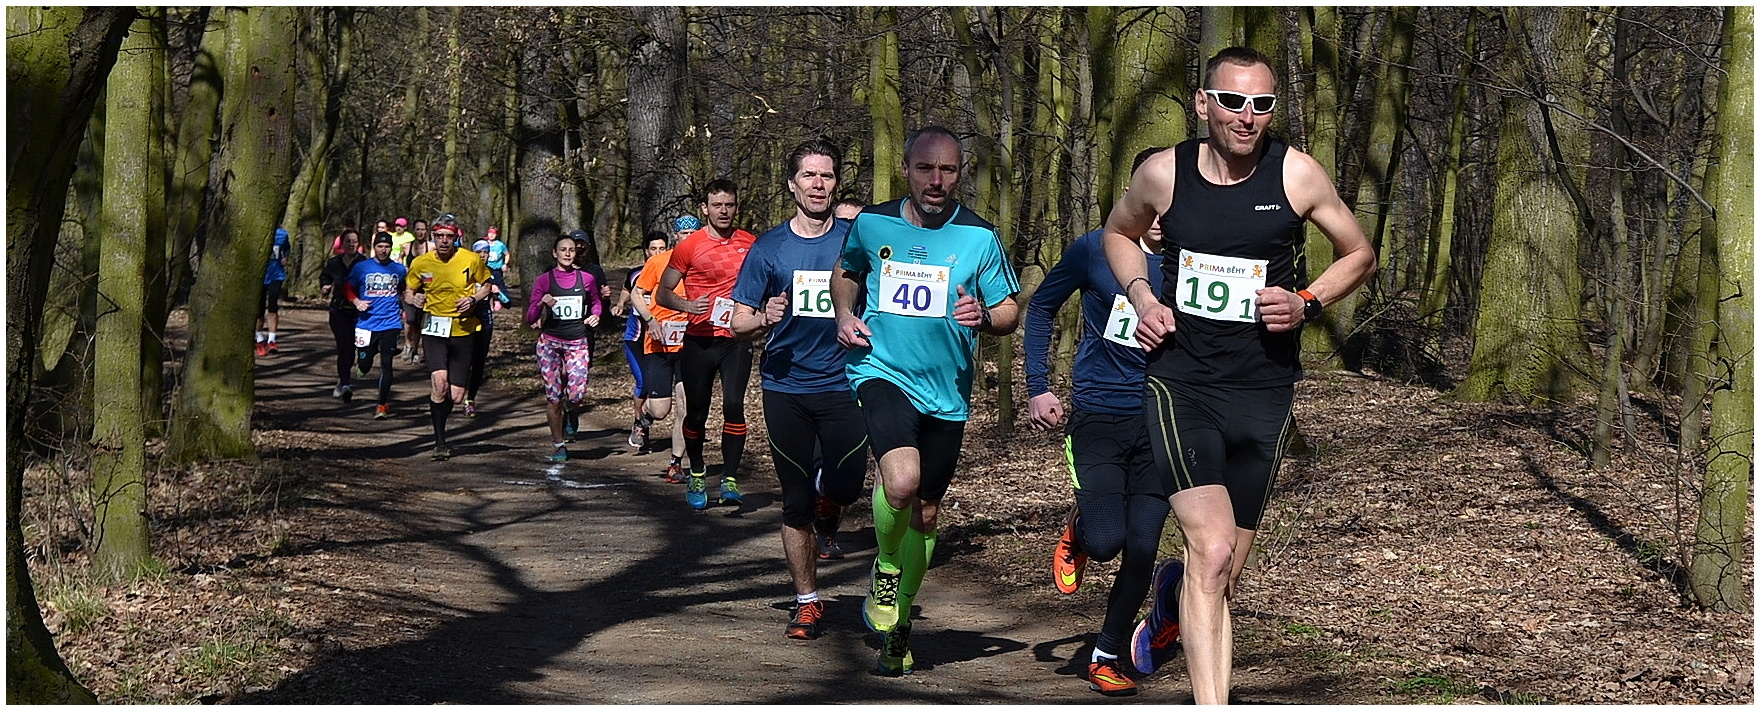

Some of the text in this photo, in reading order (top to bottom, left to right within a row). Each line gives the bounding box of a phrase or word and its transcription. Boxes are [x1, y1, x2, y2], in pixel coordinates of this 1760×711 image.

[895, 269, 916, 278] PRIMA
[1199, 263, 1246, 275] PRIMA BĚHY
[799, 289, 832, 313] 16
[892, 284, 931, 311] 40
[1183, 276, 1253, 320] 19 1
[555, 306, 579, 318] 10 1
[719, 310, 731, 324] 4
[426, 321, 439, 333] 11
[1114, 317, 1136, 340] 1
